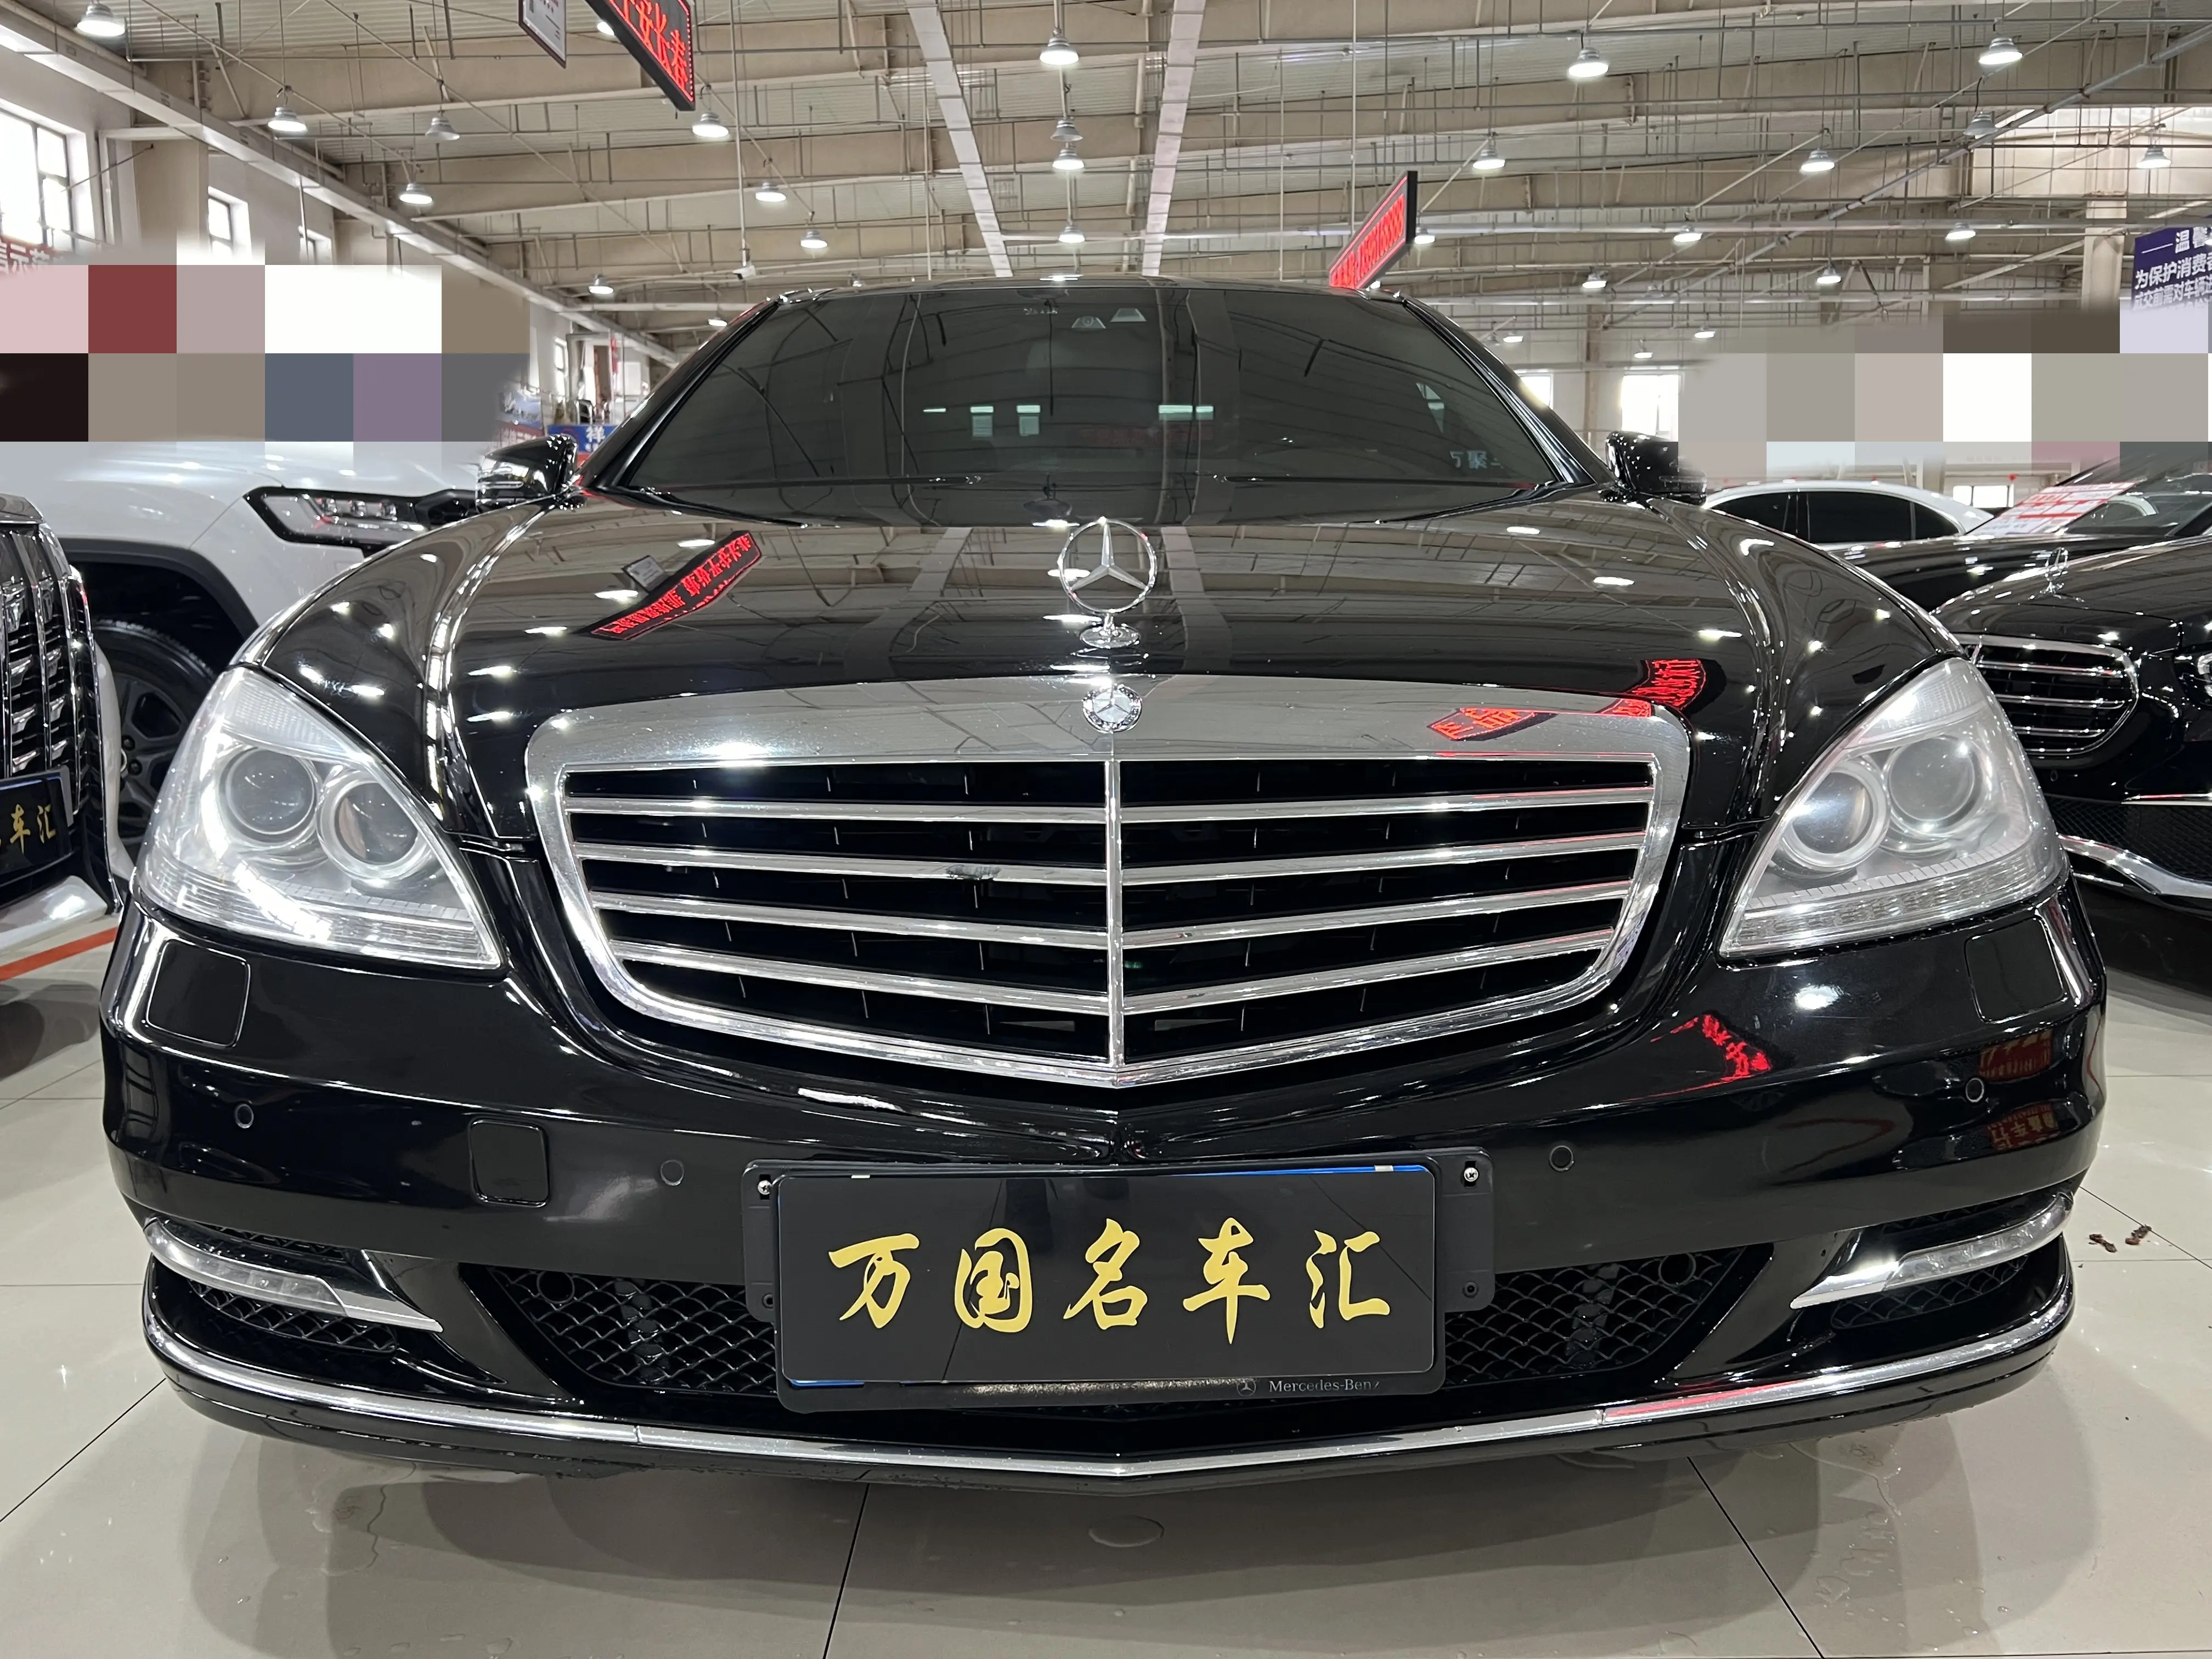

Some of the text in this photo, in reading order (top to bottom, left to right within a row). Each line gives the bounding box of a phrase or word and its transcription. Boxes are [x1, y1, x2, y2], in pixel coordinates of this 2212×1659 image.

[623, 0, 689, 90] 安长春
[2175, 225, 2212, 253] 温馨
[0, 804, 56, 854] 车汇
[828, 1217, 1391, 1345] 万国名车汇
[1269, 1378, 1380, 1392] Mercedes-Benz
